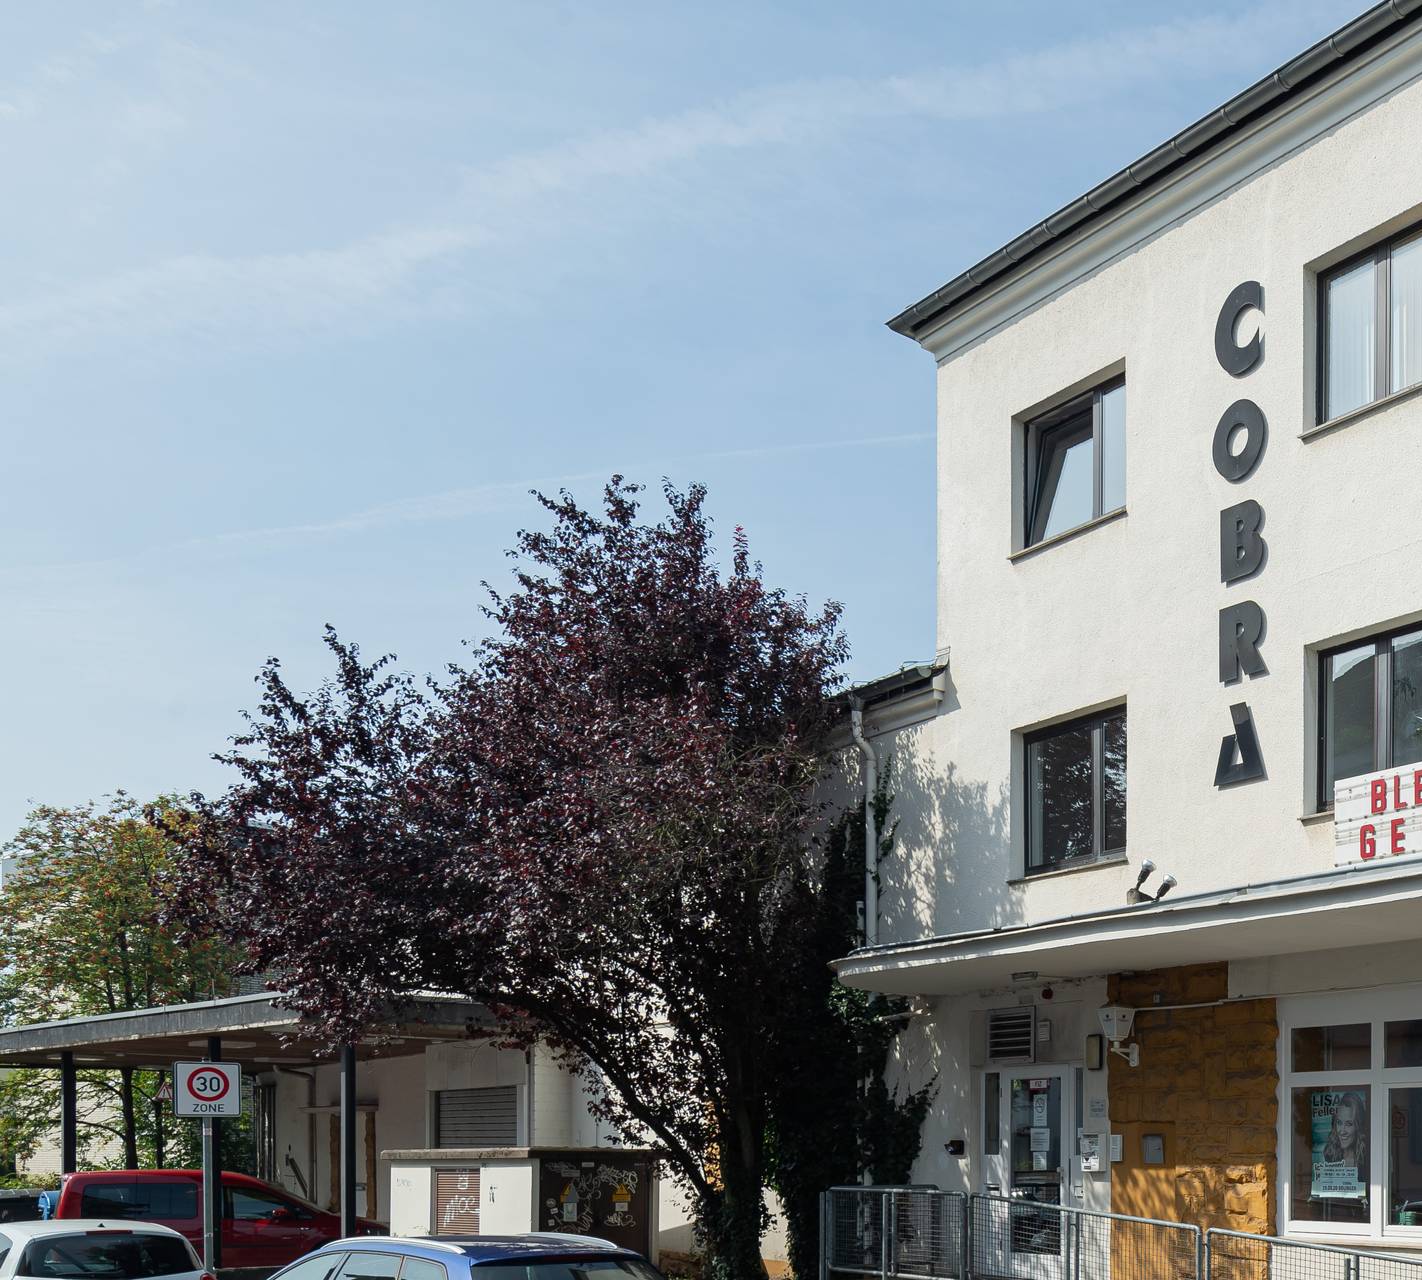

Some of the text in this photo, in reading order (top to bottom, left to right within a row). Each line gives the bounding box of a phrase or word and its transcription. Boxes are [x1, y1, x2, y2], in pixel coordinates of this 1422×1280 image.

[1213, 280, 1266, 789] COBRA
[196, 1077, 220, 1092] 30
[1313, 1094, 1341, 1106] LISA
[193, 1104, 224, 1112] ZONE
